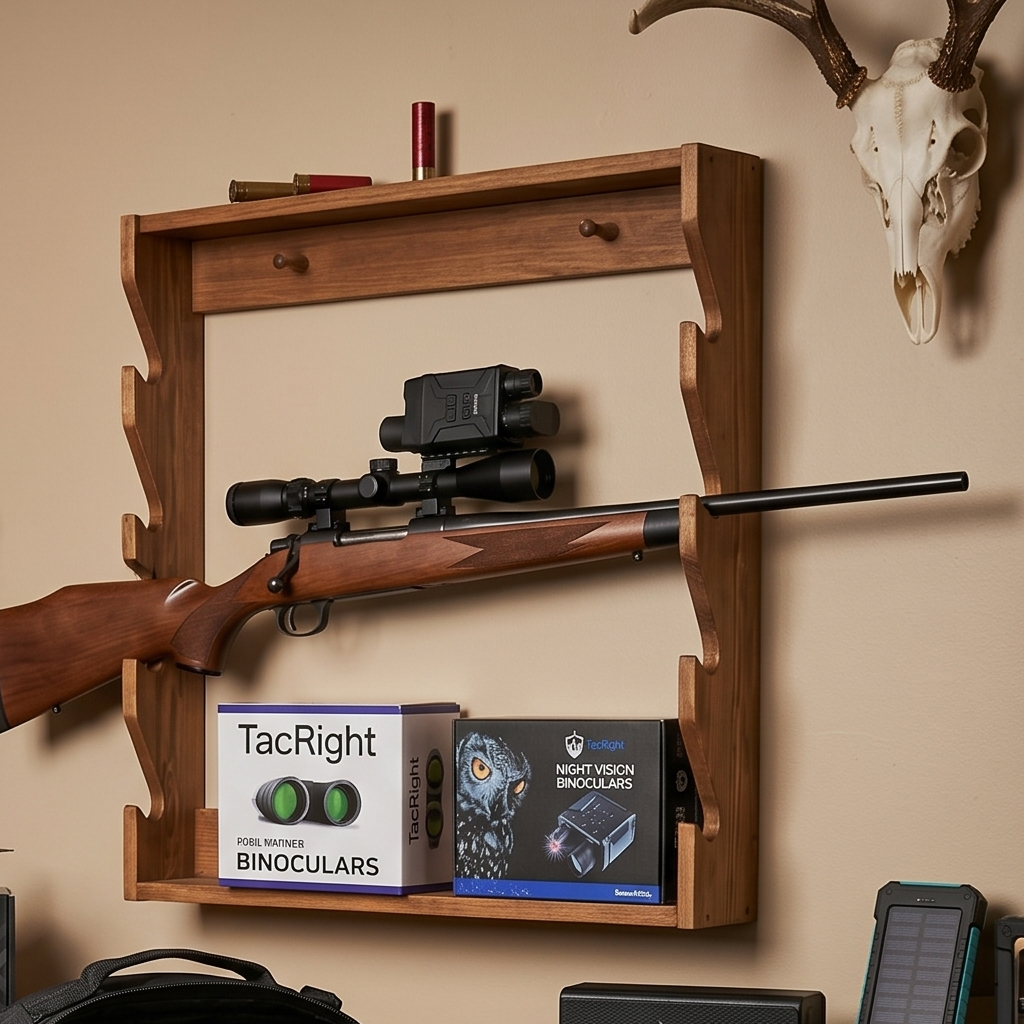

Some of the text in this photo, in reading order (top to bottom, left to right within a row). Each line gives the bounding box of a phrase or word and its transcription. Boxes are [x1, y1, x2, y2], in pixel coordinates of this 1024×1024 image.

[238, 724, 377, 765] TacRight
[555, 763, 593, 775] NIGHT
[556, 777, 634, 790] BINOCULARS
[408, 757, 422, 845] TacRight
[237, 852, 380, 876] BINOCULARS
